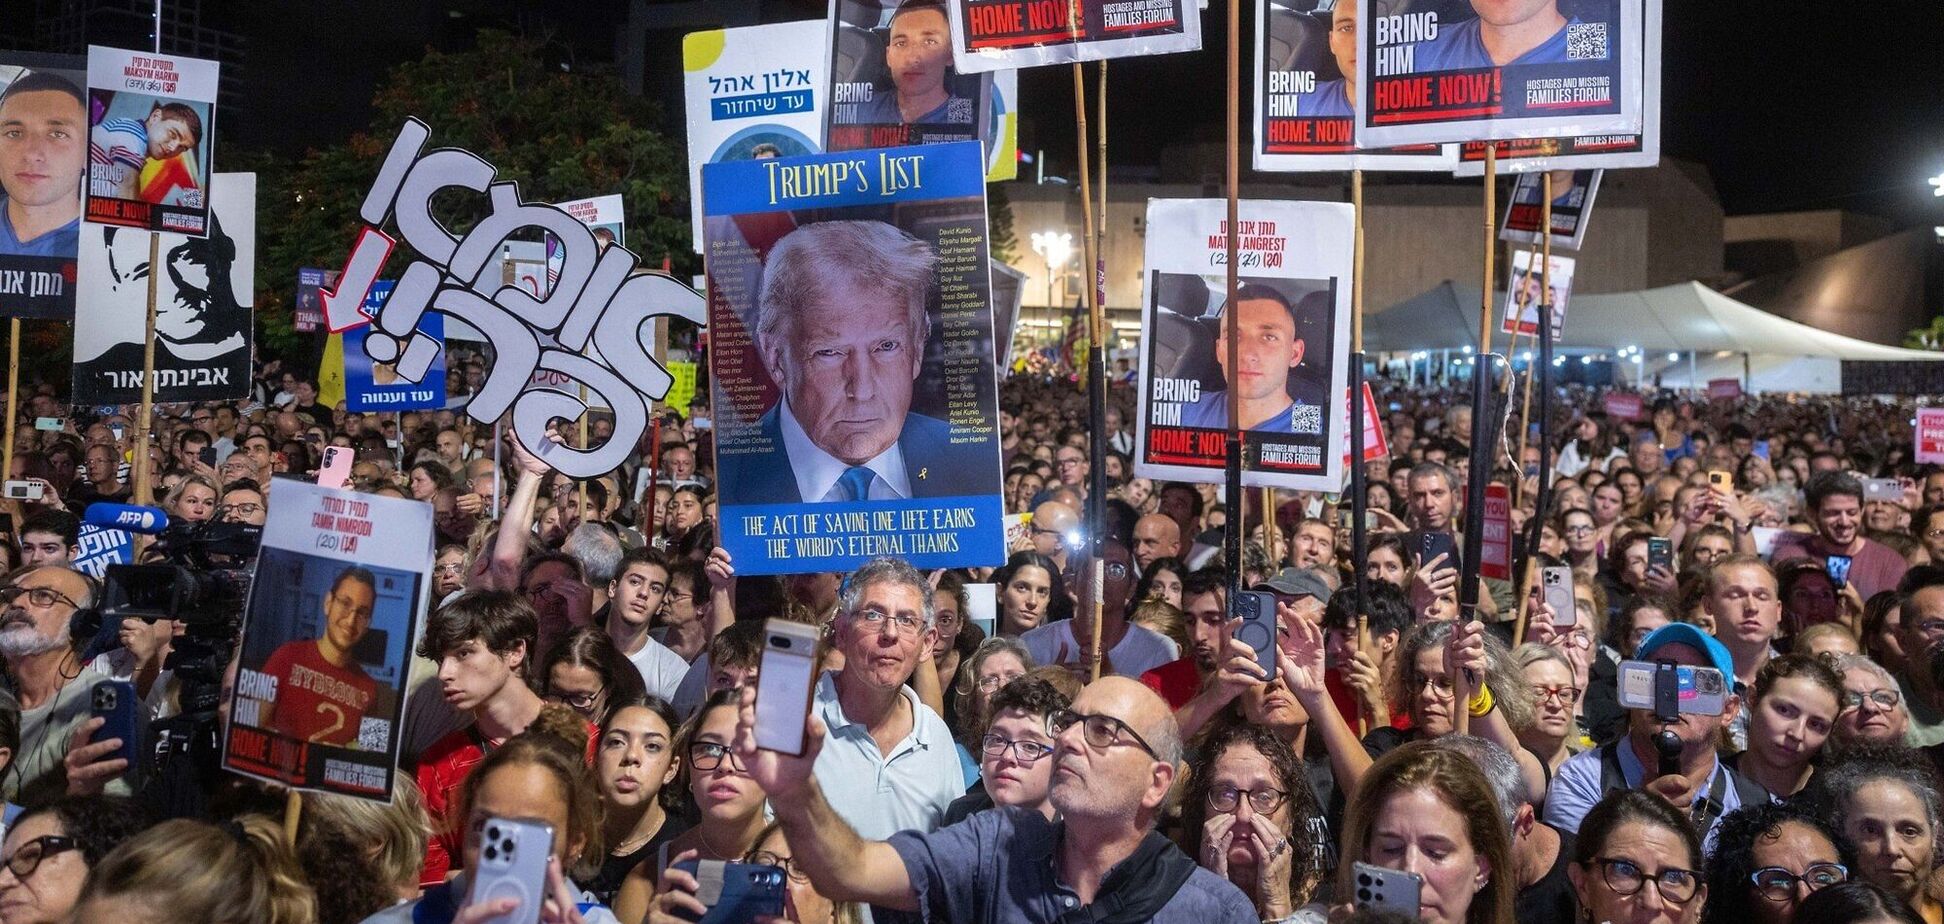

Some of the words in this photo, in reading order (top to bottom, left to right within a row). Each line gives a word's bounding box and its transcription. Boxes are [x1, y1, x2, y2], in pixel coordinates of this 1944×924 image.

[1104, 4, 1132, 14] HOSTAGES
[1133, 2, 1146, 11] AND
[1147, 0, 1173, 9] MISSING
[970, 6, 1024, 36] HOME
[1030, 1, 1085, 31] NOW!
[1103, 13, 1142, 28] FAMILIES
[1143, 9, 1174, 23] FORUM
[1375, 11, 1438, 46] BRING
[1375, 45, 1414, 76] HIM
[124, 66, 154, 79] MAKSYM
[154, 71, 179, 83] HARKIN
[709, 76, 755, 94] אהל
[762, 69, 811, 94] אלון
[1268, 70, 1316, 94] BRING
[1526, 78, 1562, 90] HOSTAGES
[1563, 78, 1577, 88] AND
[1578, 76, 1610, 87] MISSING
[834, 82, 873, 103] BRING
[1375, 76, 1433, 110] HOME
[1438, 68, 1504, 105] NOW!
[1526, 89, 1571, 105] FAMILIES
[1573, 87, 1611, 102] FORUM
[721, 97, 777, 115] שיחזור
[782, 95, 804, 109] עד
[1268, 94, 1298, 117] HIM
[833, 103, 858, 124] HIM
[1268, 120, 1312, 143] HOME
[1315, 120, 1353, 143] NOW
[91, 163, 123, 183] BRING
[763, 159, 869, 205] TRUMP'S
[880, 153, 924, 197] LIST
[90, 180, 112, 197] HIM
[88, 198, 120, 217] HOME
[123, 203, 151, 220] NOW!
[1258, 221, 1276, 236] מתן
[1208, 235, 1240, 250] MATN
[1243, 236, 1287, 251] ANGREST
[30, 271, 63, 298] מתן
[104, 370, 144, 389] אור
[1153, 378, 1201, 403] BRING
[361, 392, 406, 404] וענווה
[410, 390, 434, 401] עוז
[1151, 402, 1182, 427] HIM
[1151, 429, 1194, 453] HOME
[1261, 443, 1287, 452] HOSTAGES
[1287, 444, 1298, 452] AND
[1298, 445, 1321, 454] MISSING
[1261, 451, 1293, 465] FAMILIES
[1294, 453, 1321, 466] FORUM
[116, 511, 142, 524] AFP
[1485, 501, 1506, 515] YOU
[312, 512, 335, 531] TAMIR
[336, 517, 373, 537] NIMRODI
[741, 515, 768, 536] THE
[772, 514, 799, 535] ACT
[803, 513, 820, 534] OF
[825, 511, 869, 534] SAVING
[873, 510, 897, 532] ONE
[901, 509, 928, 531] LIFE
[932, 507, 976, 529] EARNS
[765, 538, 791, 559] THE
[794, 535, 845, 558] WORLD'S
[848, 533, 907, 557] ETERNAL
[910, 532, 959, 554] THANKS
[237, 668, 279, 703] BRING
[233, 697, 261, 727] HIM
[308, 701, 345, 742] 2
[230, 728, 267, 760] HOME
[324, 768, 358, 786] FAMILIES
[359, 774, 387, 791] FORUM
